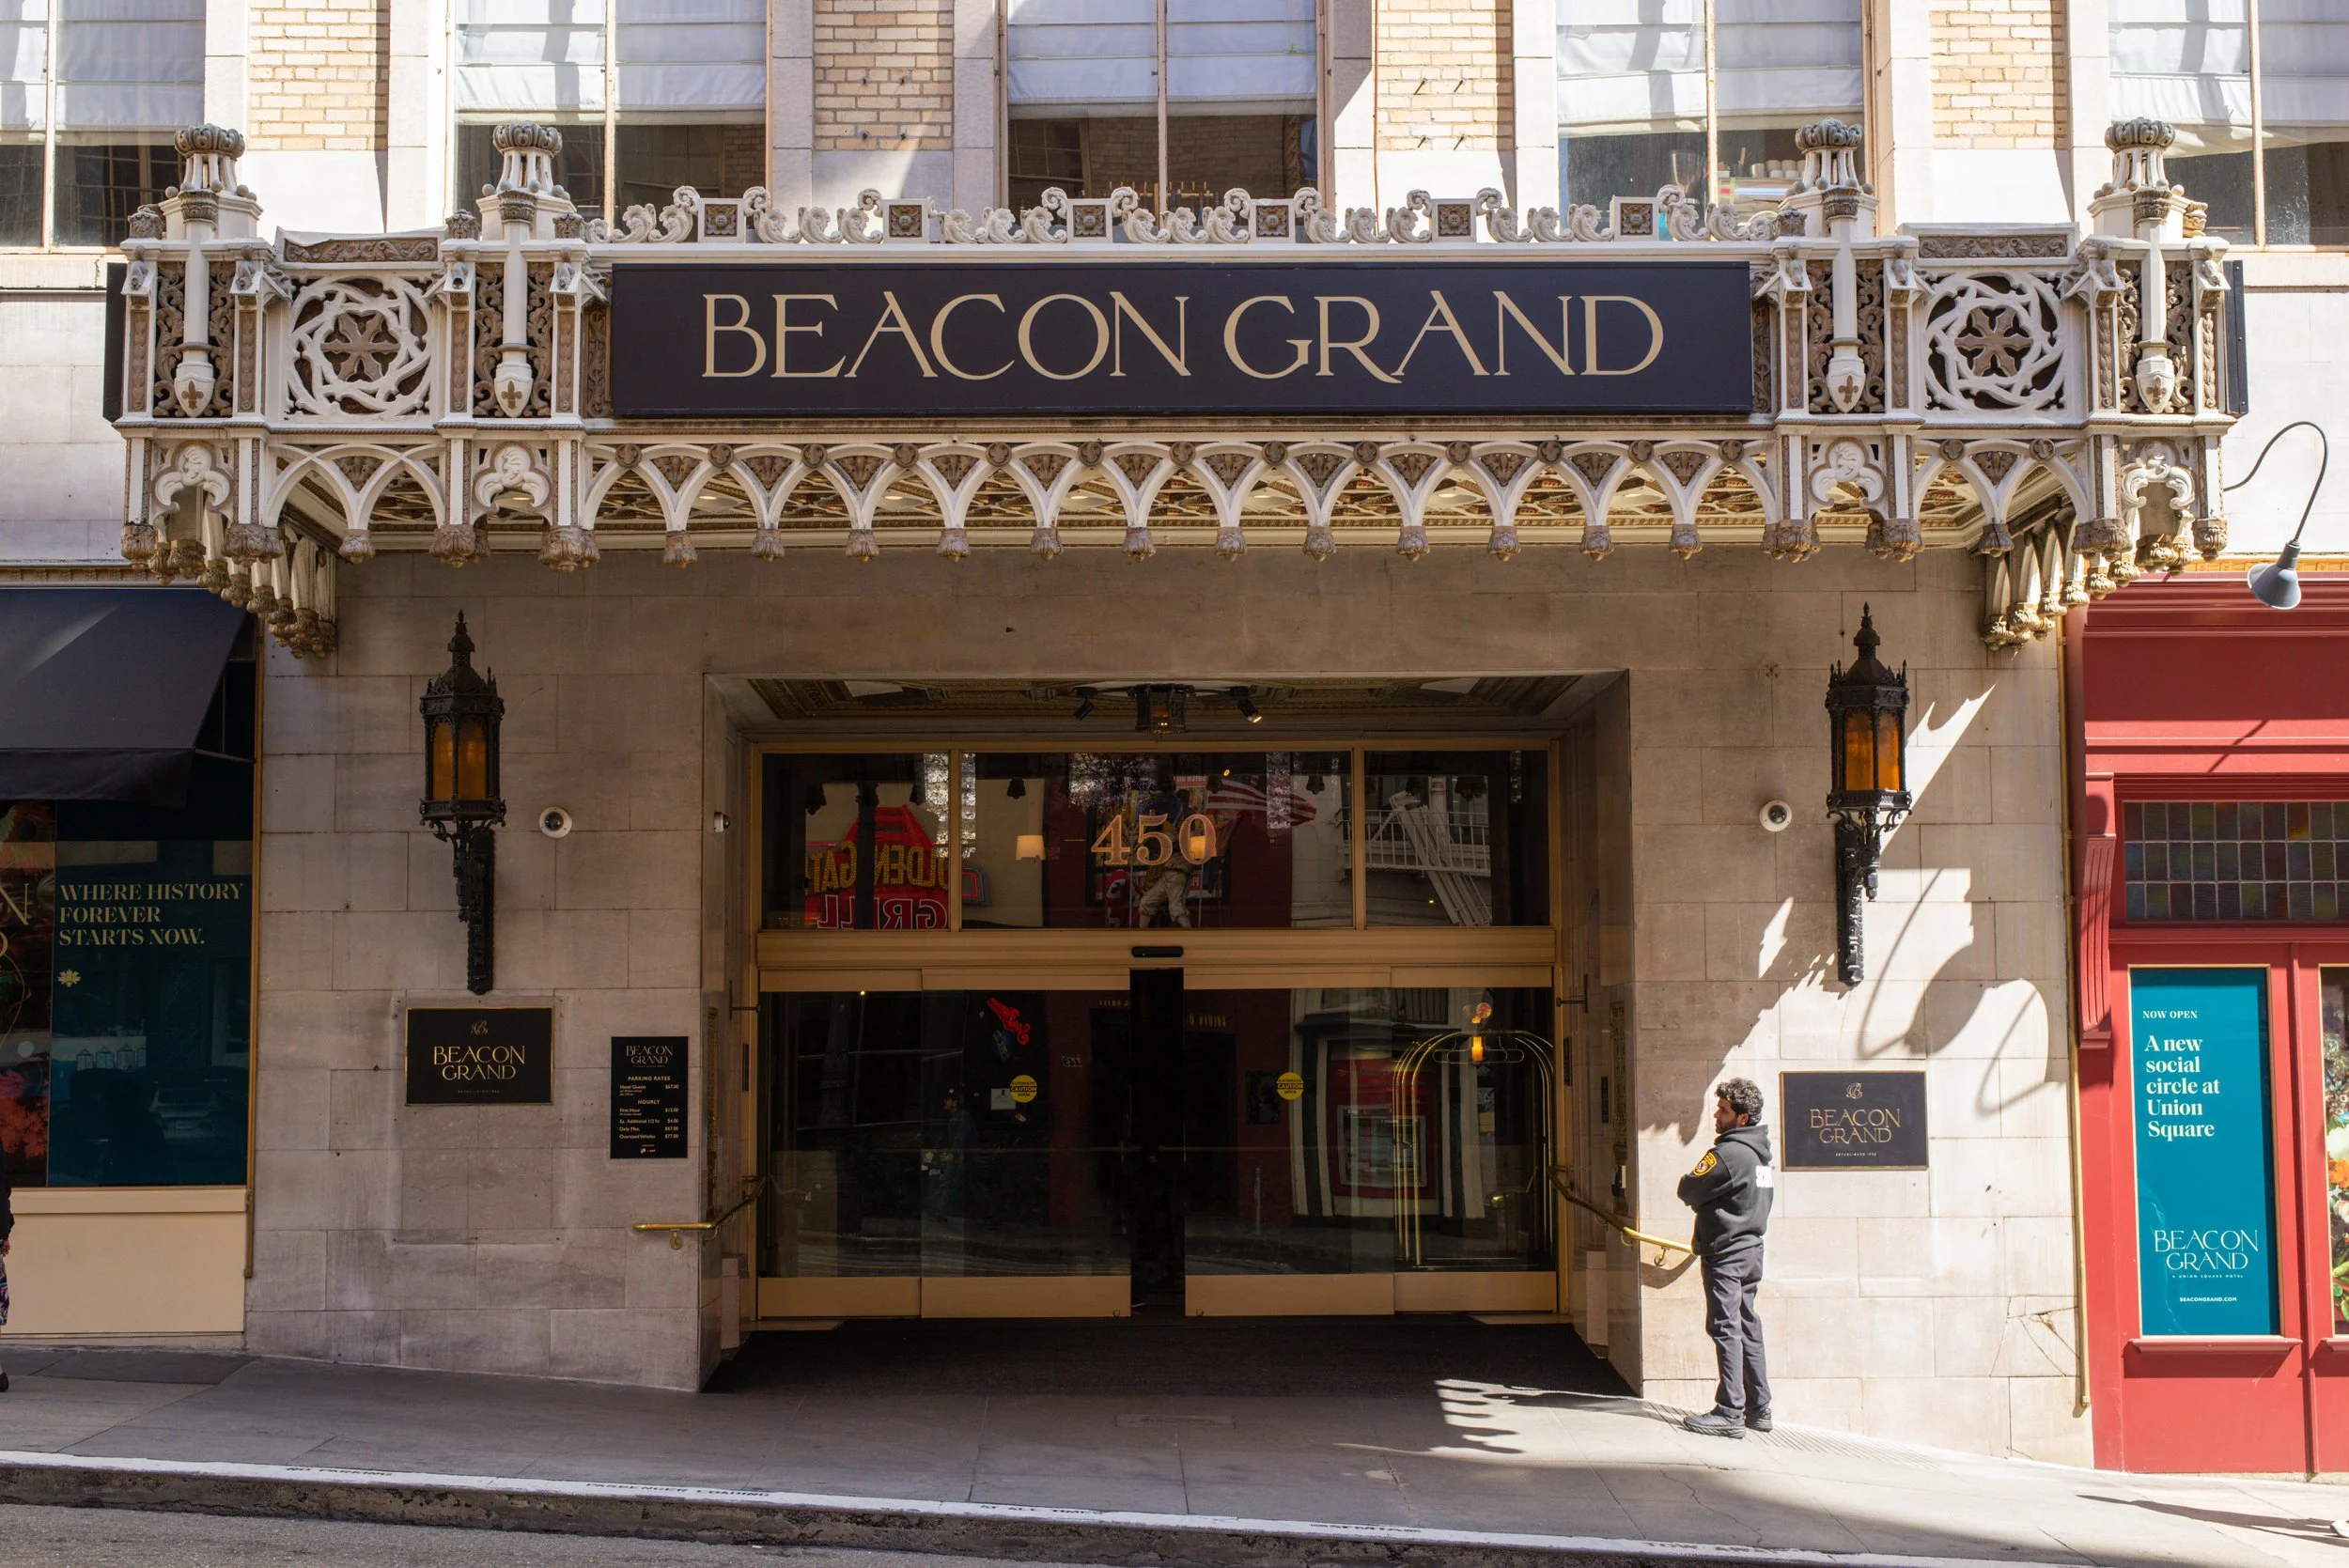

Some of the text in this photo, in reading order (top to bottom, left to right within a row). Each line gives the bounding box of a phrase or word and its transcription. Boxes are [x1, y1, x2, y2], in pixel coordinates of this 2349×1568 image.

[702, 290, 1663, 383] BEACON GRAND
[1091, 814, 1218, 865] 450
[60, 883, 244, 901] WHERE HISTORY
[60, 907, 161, 924] FOREVER
[59, 928, 206, 946] STARTS NOW.
[2142, 1010, 2198, 1018] NOW OPEN
[626, 1045, 673, 1057] BEACON
[2144, 1034, 2202, 1051] A new
[433, 1046, 525, 1065] BEACON
[630, 1056, 668, 1064] GRAND
[442, 1063, 517, 1080] GRAND
[2146, 1056, 2201, 1073] social
[2146, 1077, 2220, 1094] circle at
[2147, 1099, 2202, 1115] Union
[1810, 1109, 1901, 1128] BEACON
[1819, 1126, 1892, 1144] GRAND
[2148, 1120, 2216, 1141] Square
[2155, 1229, 2259, 1252] BEACON
[2166, 1251, 2248, 1271] GRAND
[586, 1483, 688, 1492] PASSENGER
